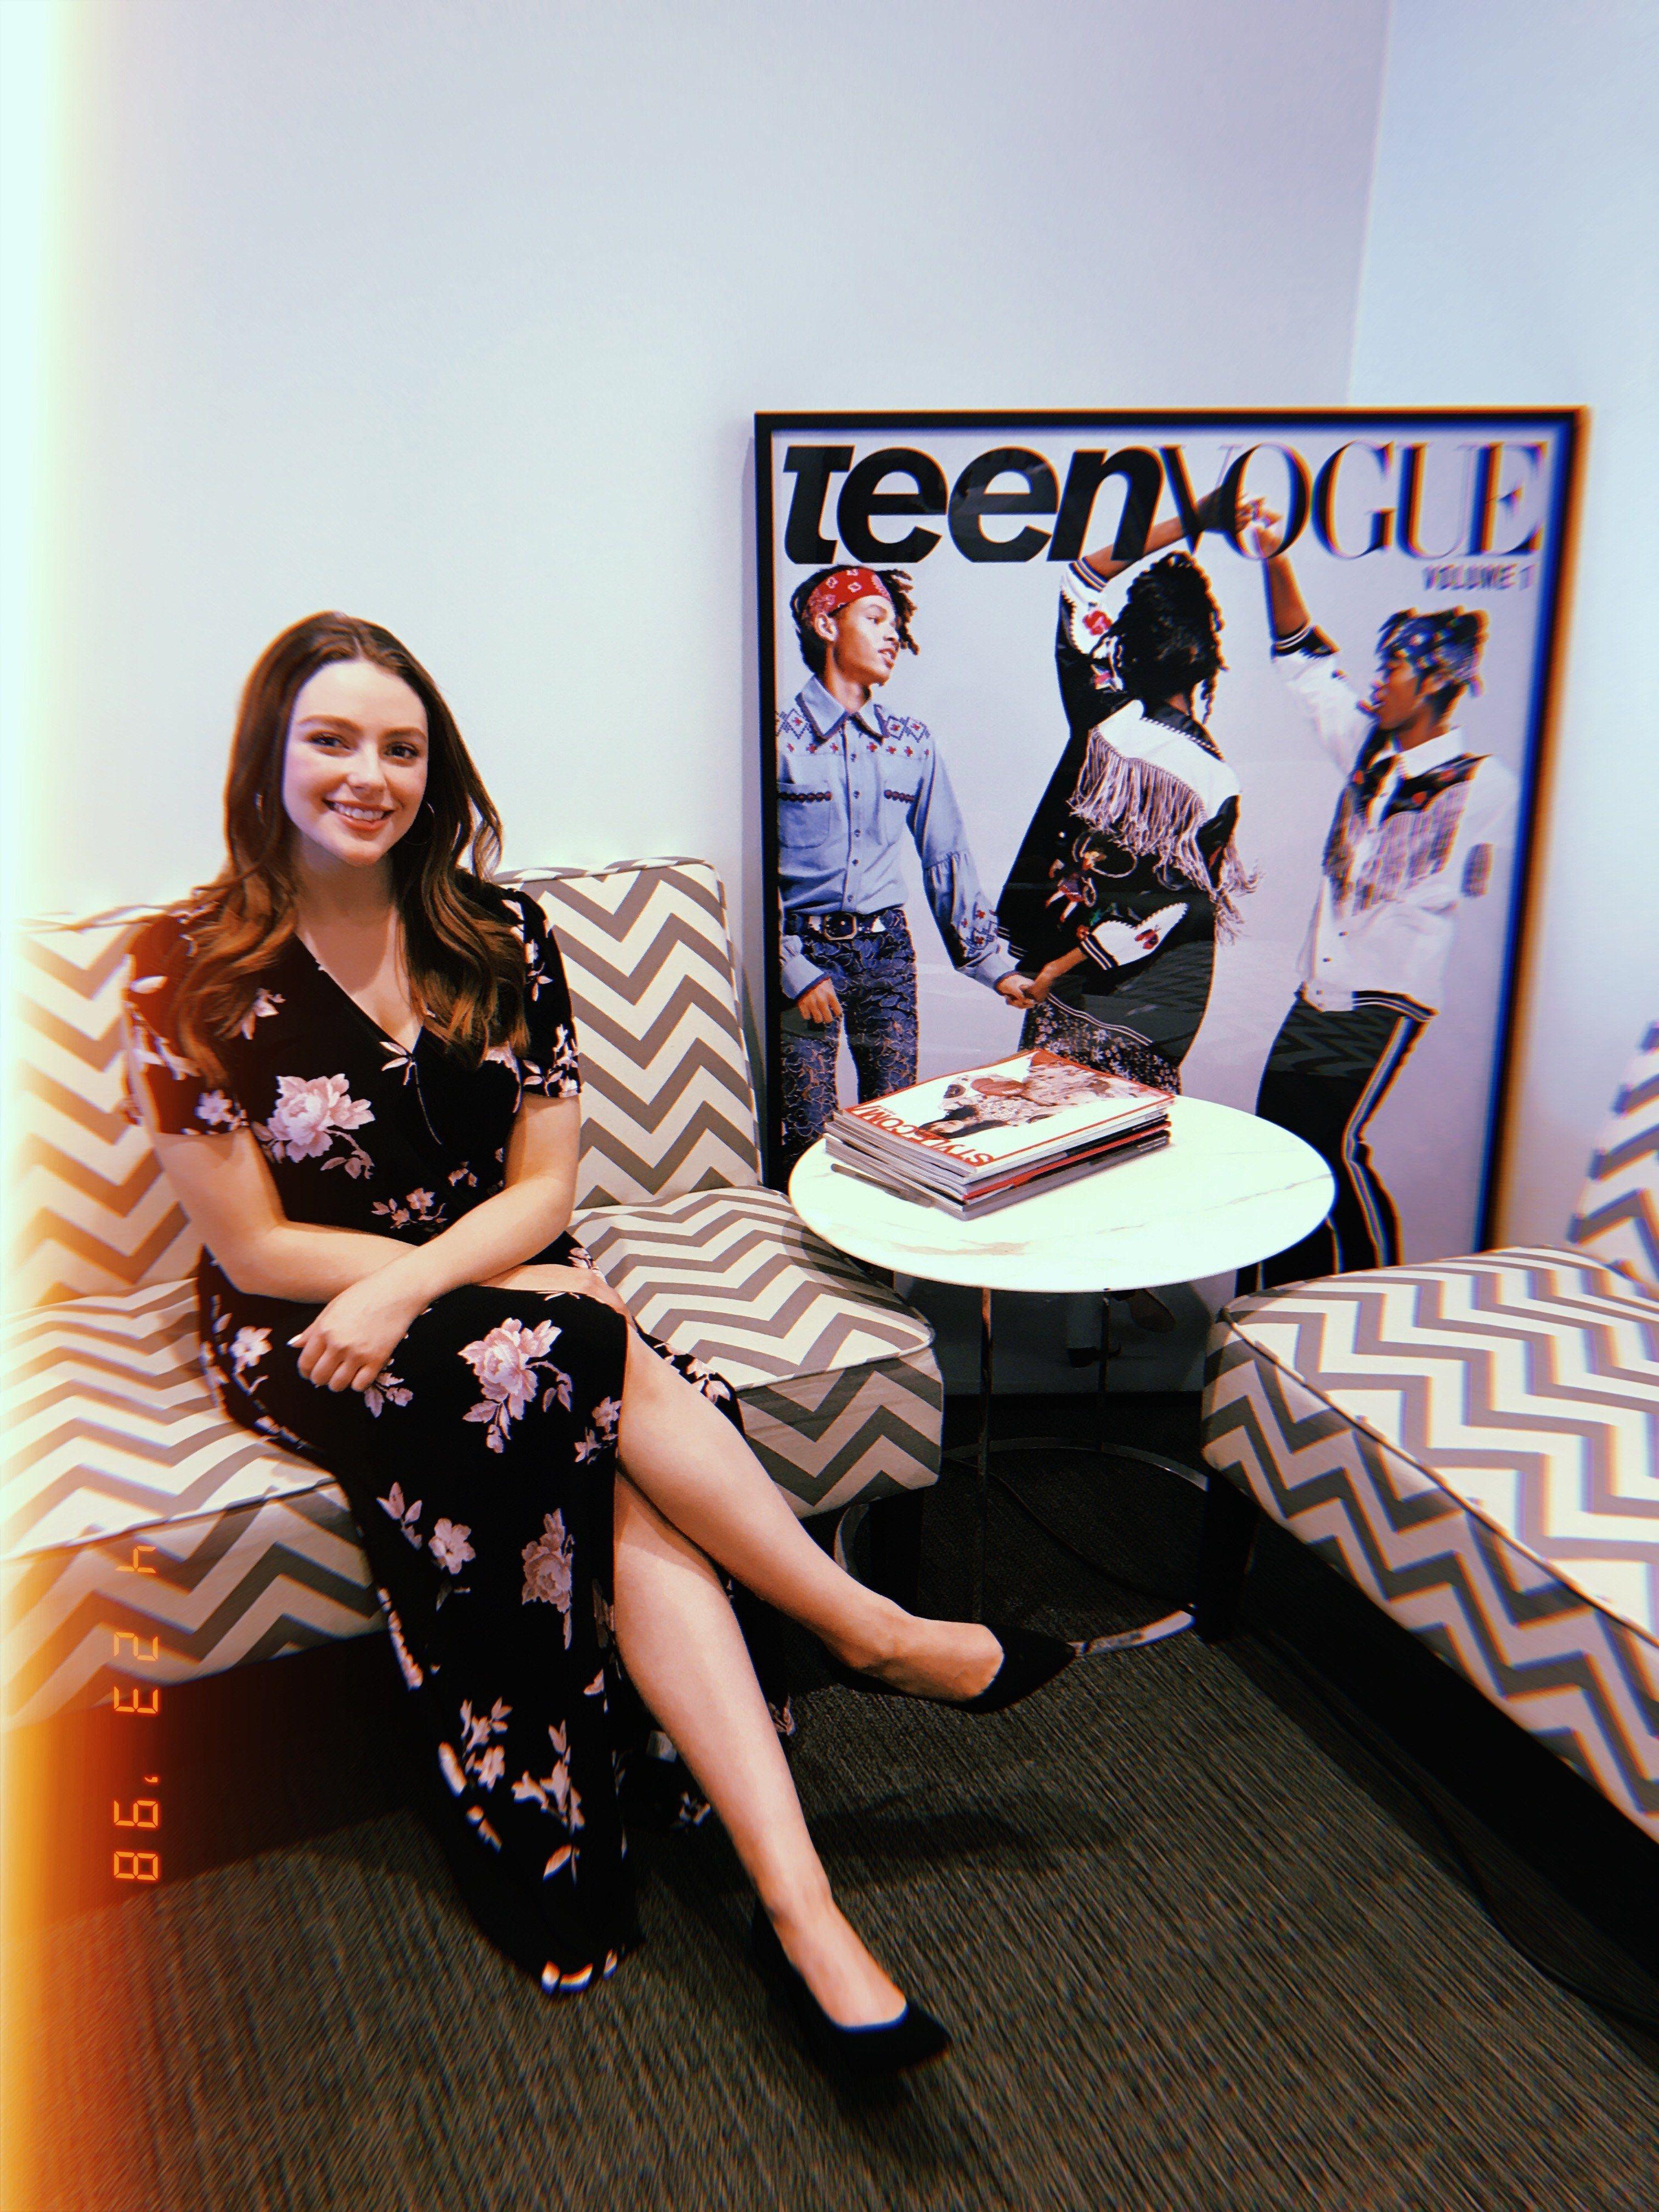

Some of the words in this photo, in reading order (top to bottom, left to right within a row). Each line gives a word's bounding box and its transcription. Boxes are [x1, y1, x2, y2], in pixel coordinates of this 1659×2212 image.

[783, 444, 1164, 564] teen
[1153, 441, 1548, 560] VOGUE
[1422, 563, 1517, 591] VOLUME
